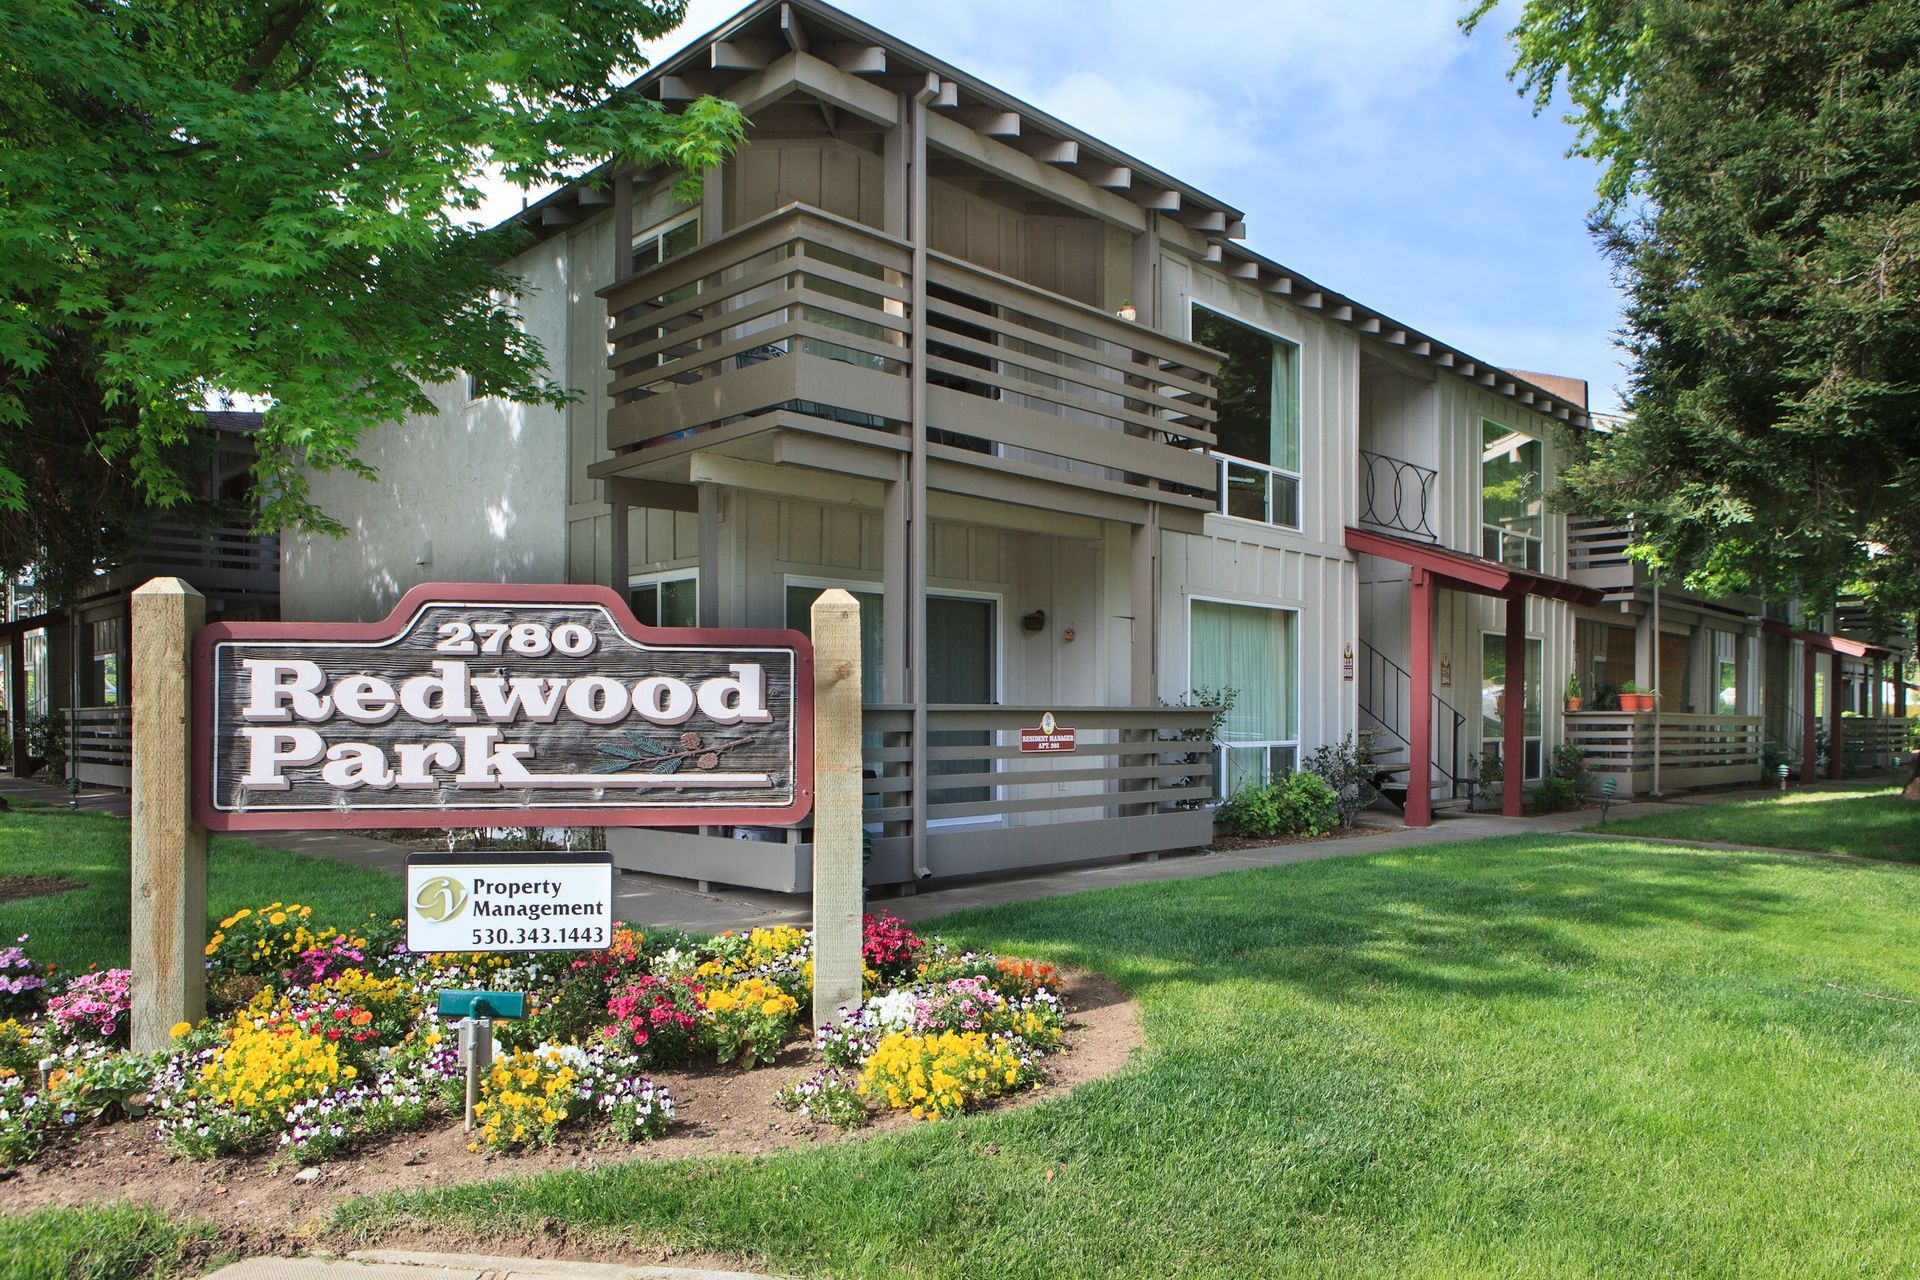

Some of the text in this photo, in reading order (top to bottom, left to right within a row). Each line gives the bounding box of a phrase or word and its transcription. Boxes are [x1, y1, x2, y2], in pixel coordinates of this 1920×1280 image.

[437, 622, 596, 656] 2780
[242, 658, 774, 724] Redwood
[242, 727, 536, 791] Park
[473, 878, 562, 898] Property
[472, 900, 604, 920] Management
[472, 927, 604, 945] 530.343.1443
